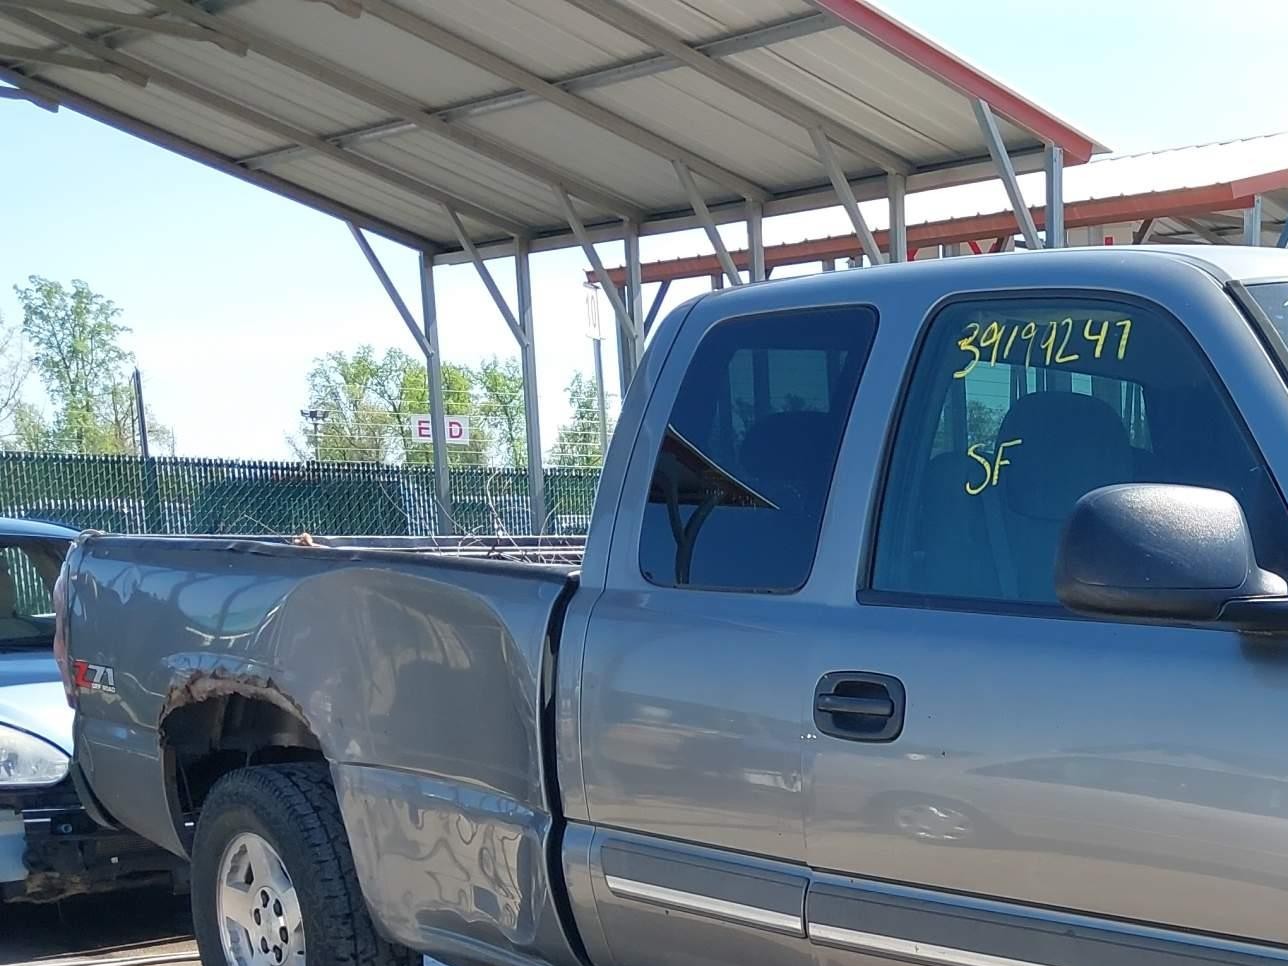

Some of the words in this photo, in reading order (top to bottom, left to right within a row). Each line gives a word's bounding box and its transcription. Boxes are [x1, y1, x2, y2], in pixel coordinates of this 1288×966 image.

[953, 317, 1132, 379] 39199247
[418, 420, 463, 438] ED
[965, 439, 1022, 495] SF
[73, 660, 115, 688] Z71
